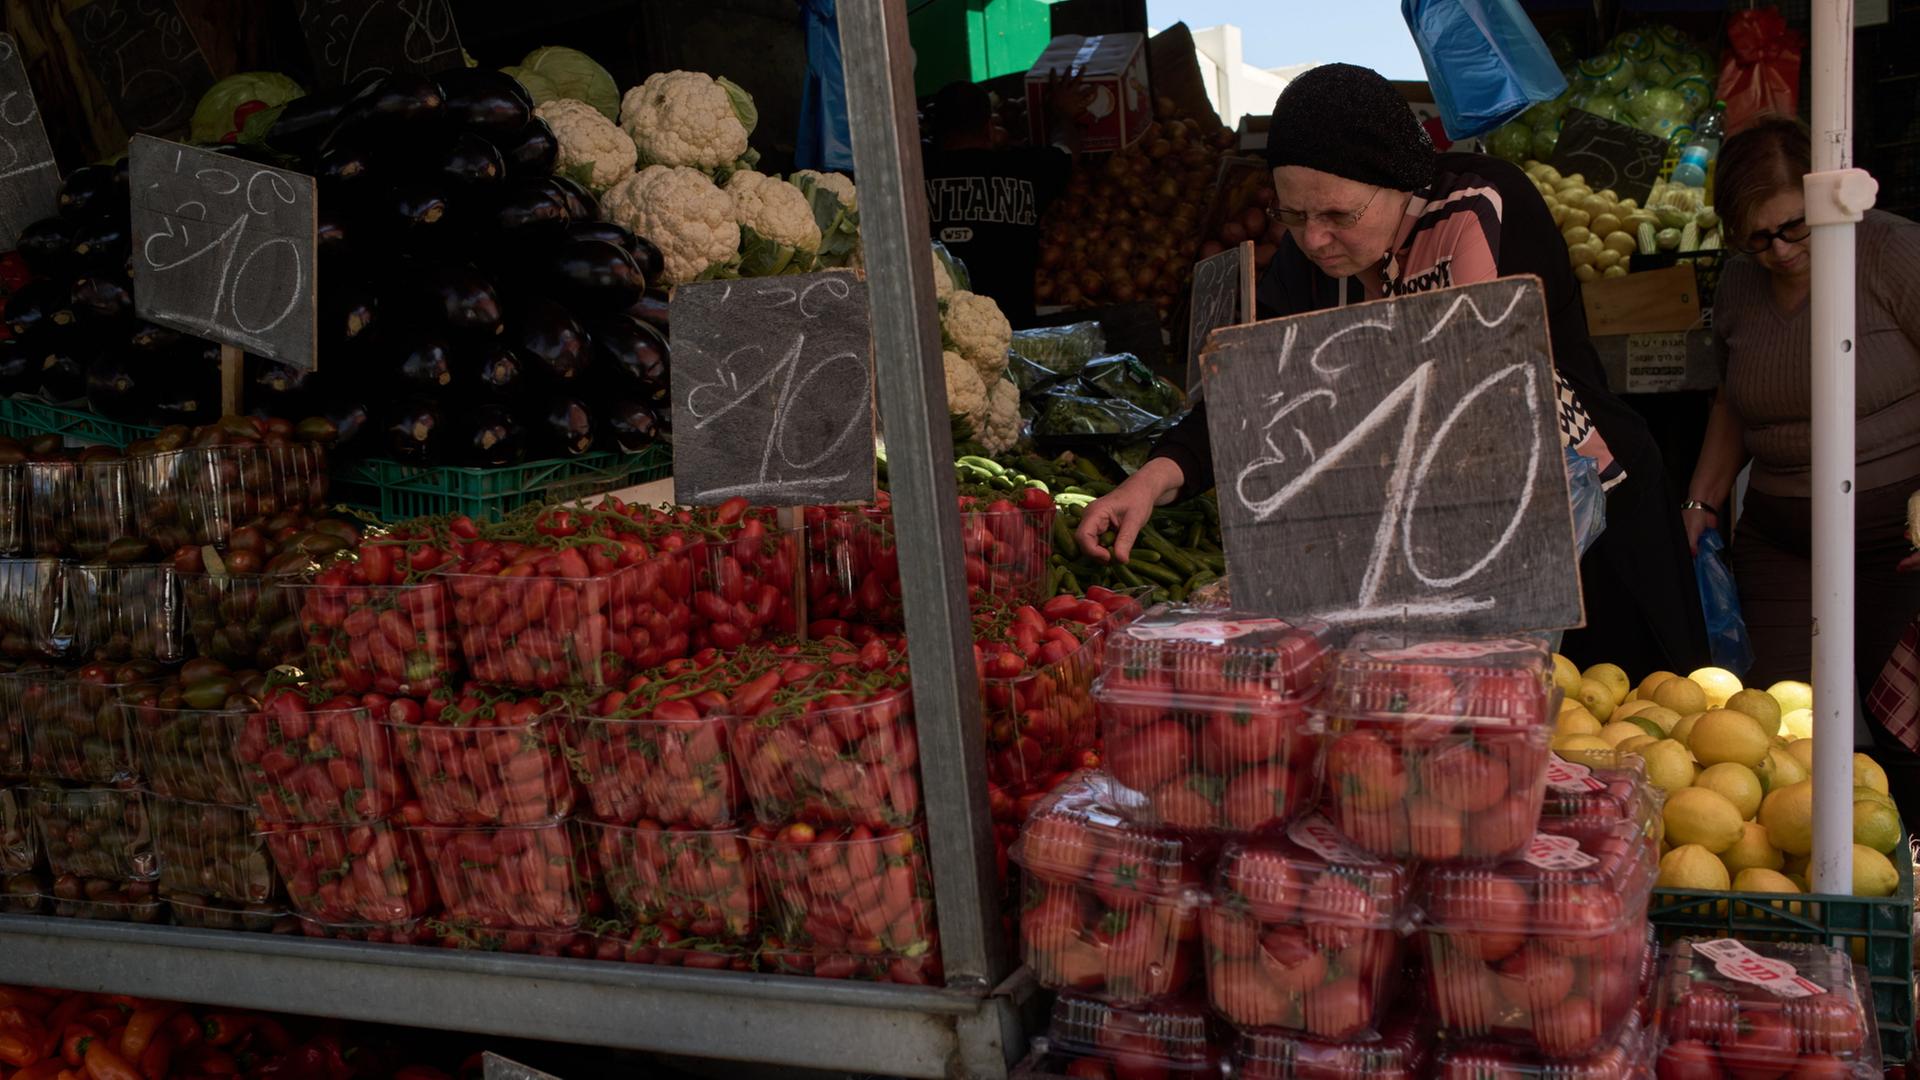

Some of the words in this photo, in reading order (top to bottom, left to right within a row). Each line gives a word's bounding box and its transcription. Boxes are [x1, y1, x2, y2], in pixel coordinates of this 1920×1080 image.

[153, 213, 302, 334] 10
[694, 334, 870, 486] 10
[1253, 358, 1542, 608] 10
